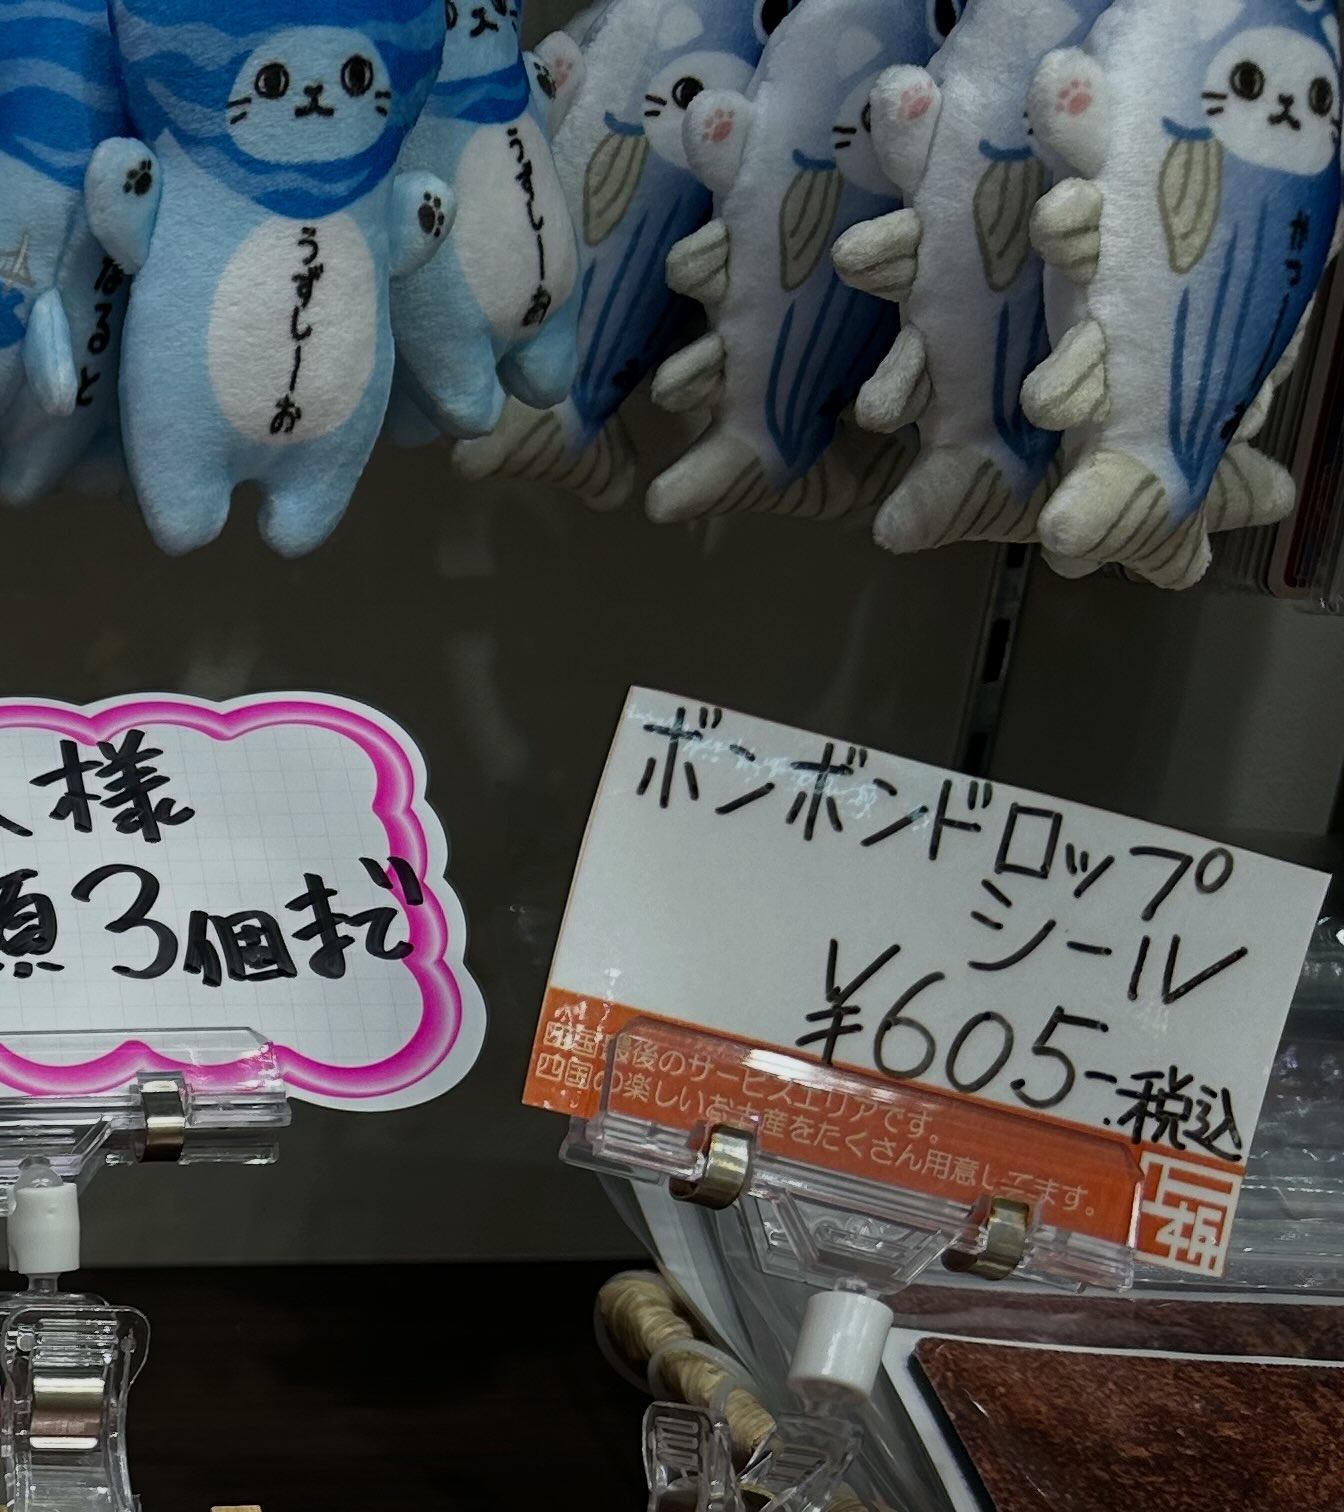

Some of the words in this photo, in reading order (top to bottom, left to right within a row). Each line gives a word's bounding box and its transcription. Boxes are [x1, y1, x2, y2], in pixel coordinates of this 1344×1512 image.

[636, 706, 1234, 921] ボンボンドロップ
[968, 878, 1248, 1004] シール
